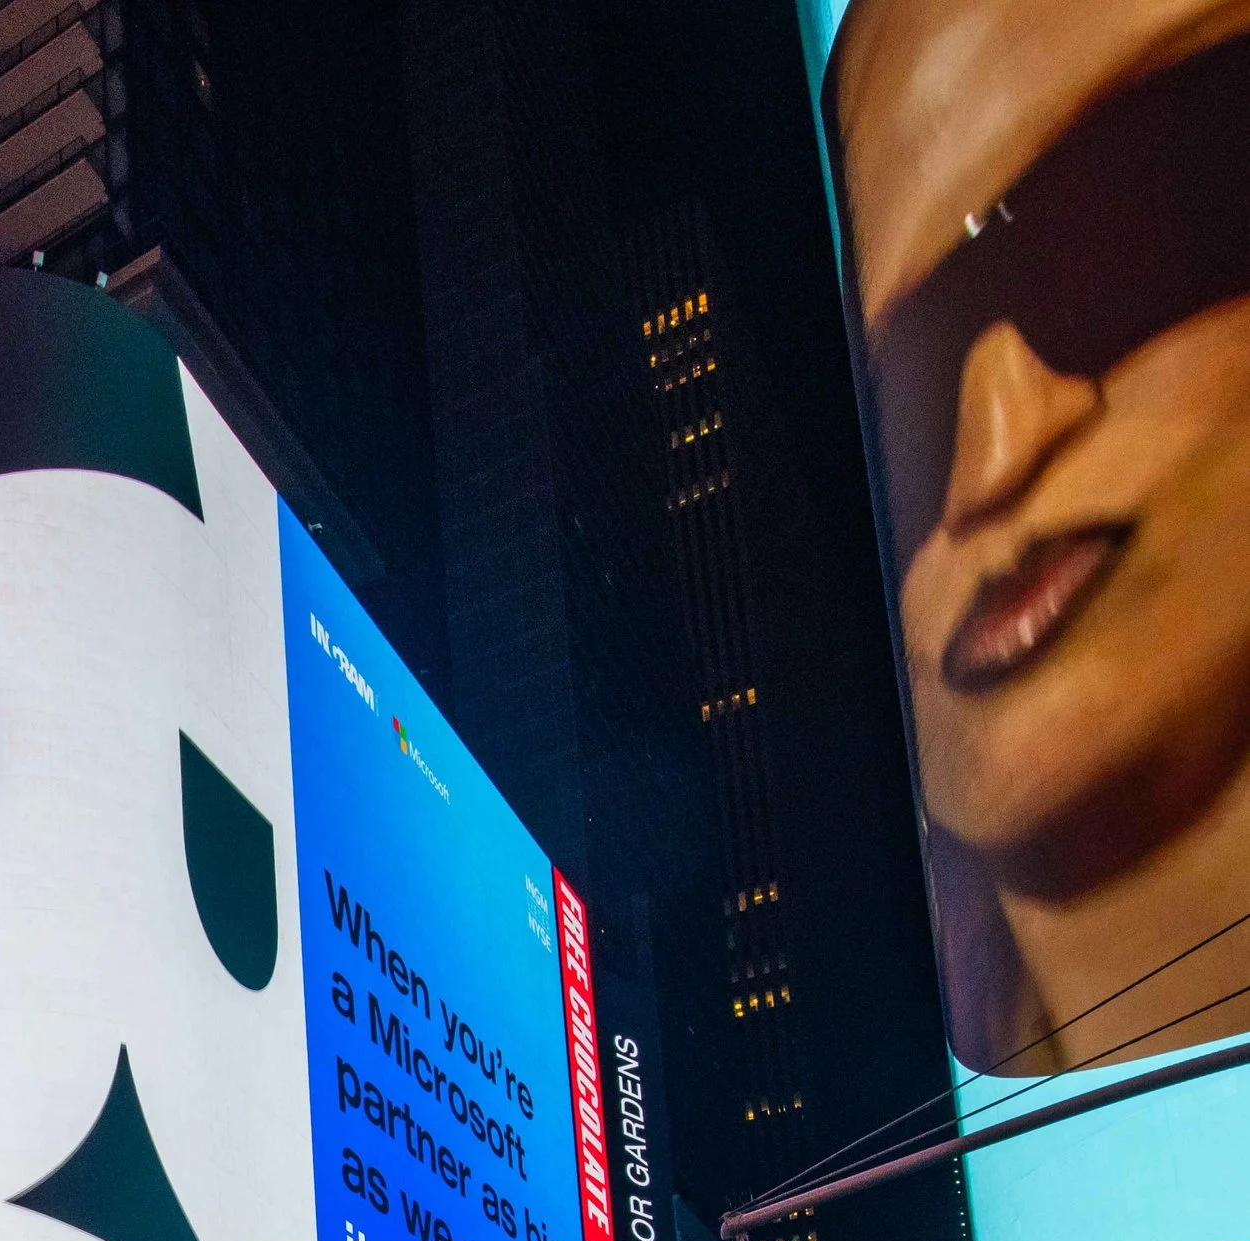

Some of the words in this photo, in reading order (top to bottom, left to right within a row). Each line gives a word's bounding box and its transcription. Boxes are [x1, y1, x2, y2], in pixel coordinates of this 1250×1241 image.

[409, 740, 451, 806] Microsoft
[324, 868, 431, 1022] When
[440, 996, 535, 1121] you're
[528, 911, 552, 953] NYSE
[560, 880, 589, 992] FREE
[331, 971, 356, 1025] a
[368, 992, 528, 1182] Microsoft
[336, 1054, 472, 1198] partner
[482, 1182, 517, 1239] as
[569, 985, 611, 1238] CHOCOLATE
[614, 1034, 651, 1188] GARDENS
[342, 1146, 390, 1216] as
